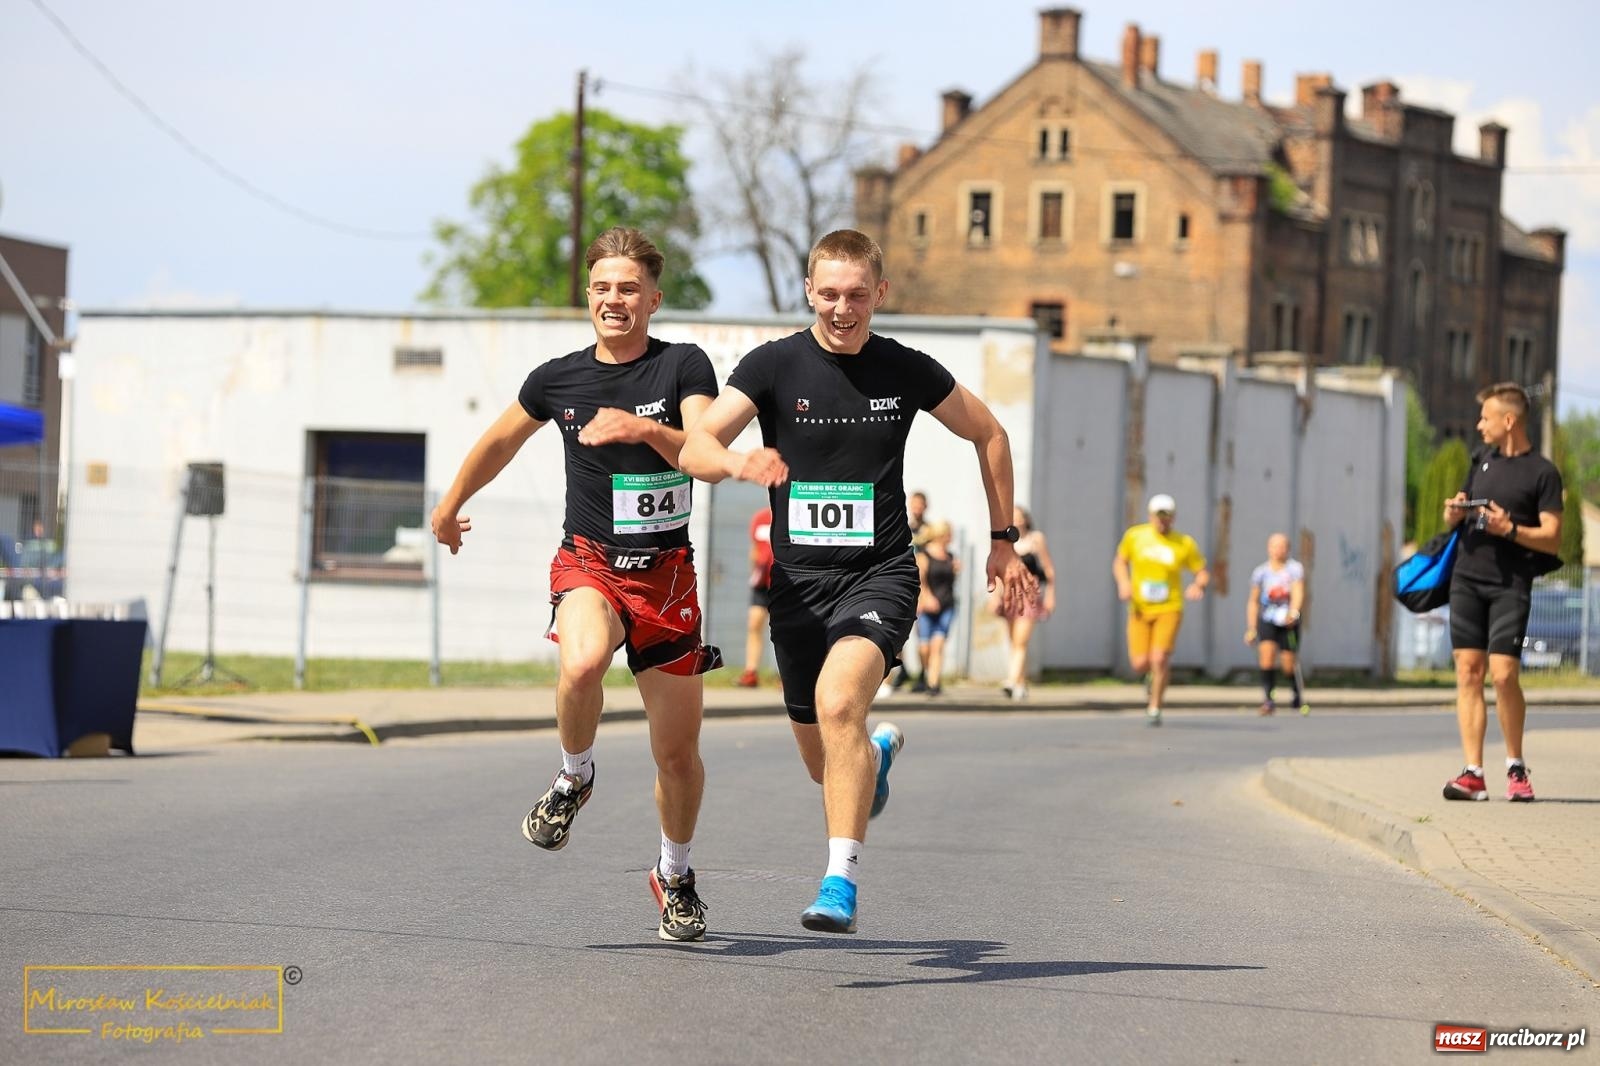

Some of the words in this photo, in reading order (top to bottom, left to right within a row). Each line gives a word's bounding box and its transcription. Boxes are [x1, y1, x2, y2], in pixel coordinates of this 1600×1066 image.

[635, 399, 665, 417] DZIK
[869, 397, 899, 411] DZIK
[862, 414, 901, 422] POLSKA
[637, 491, 675, 517] 84
[807, 503, 853, 529] 101
[614, 556, 651, 569] UFC
